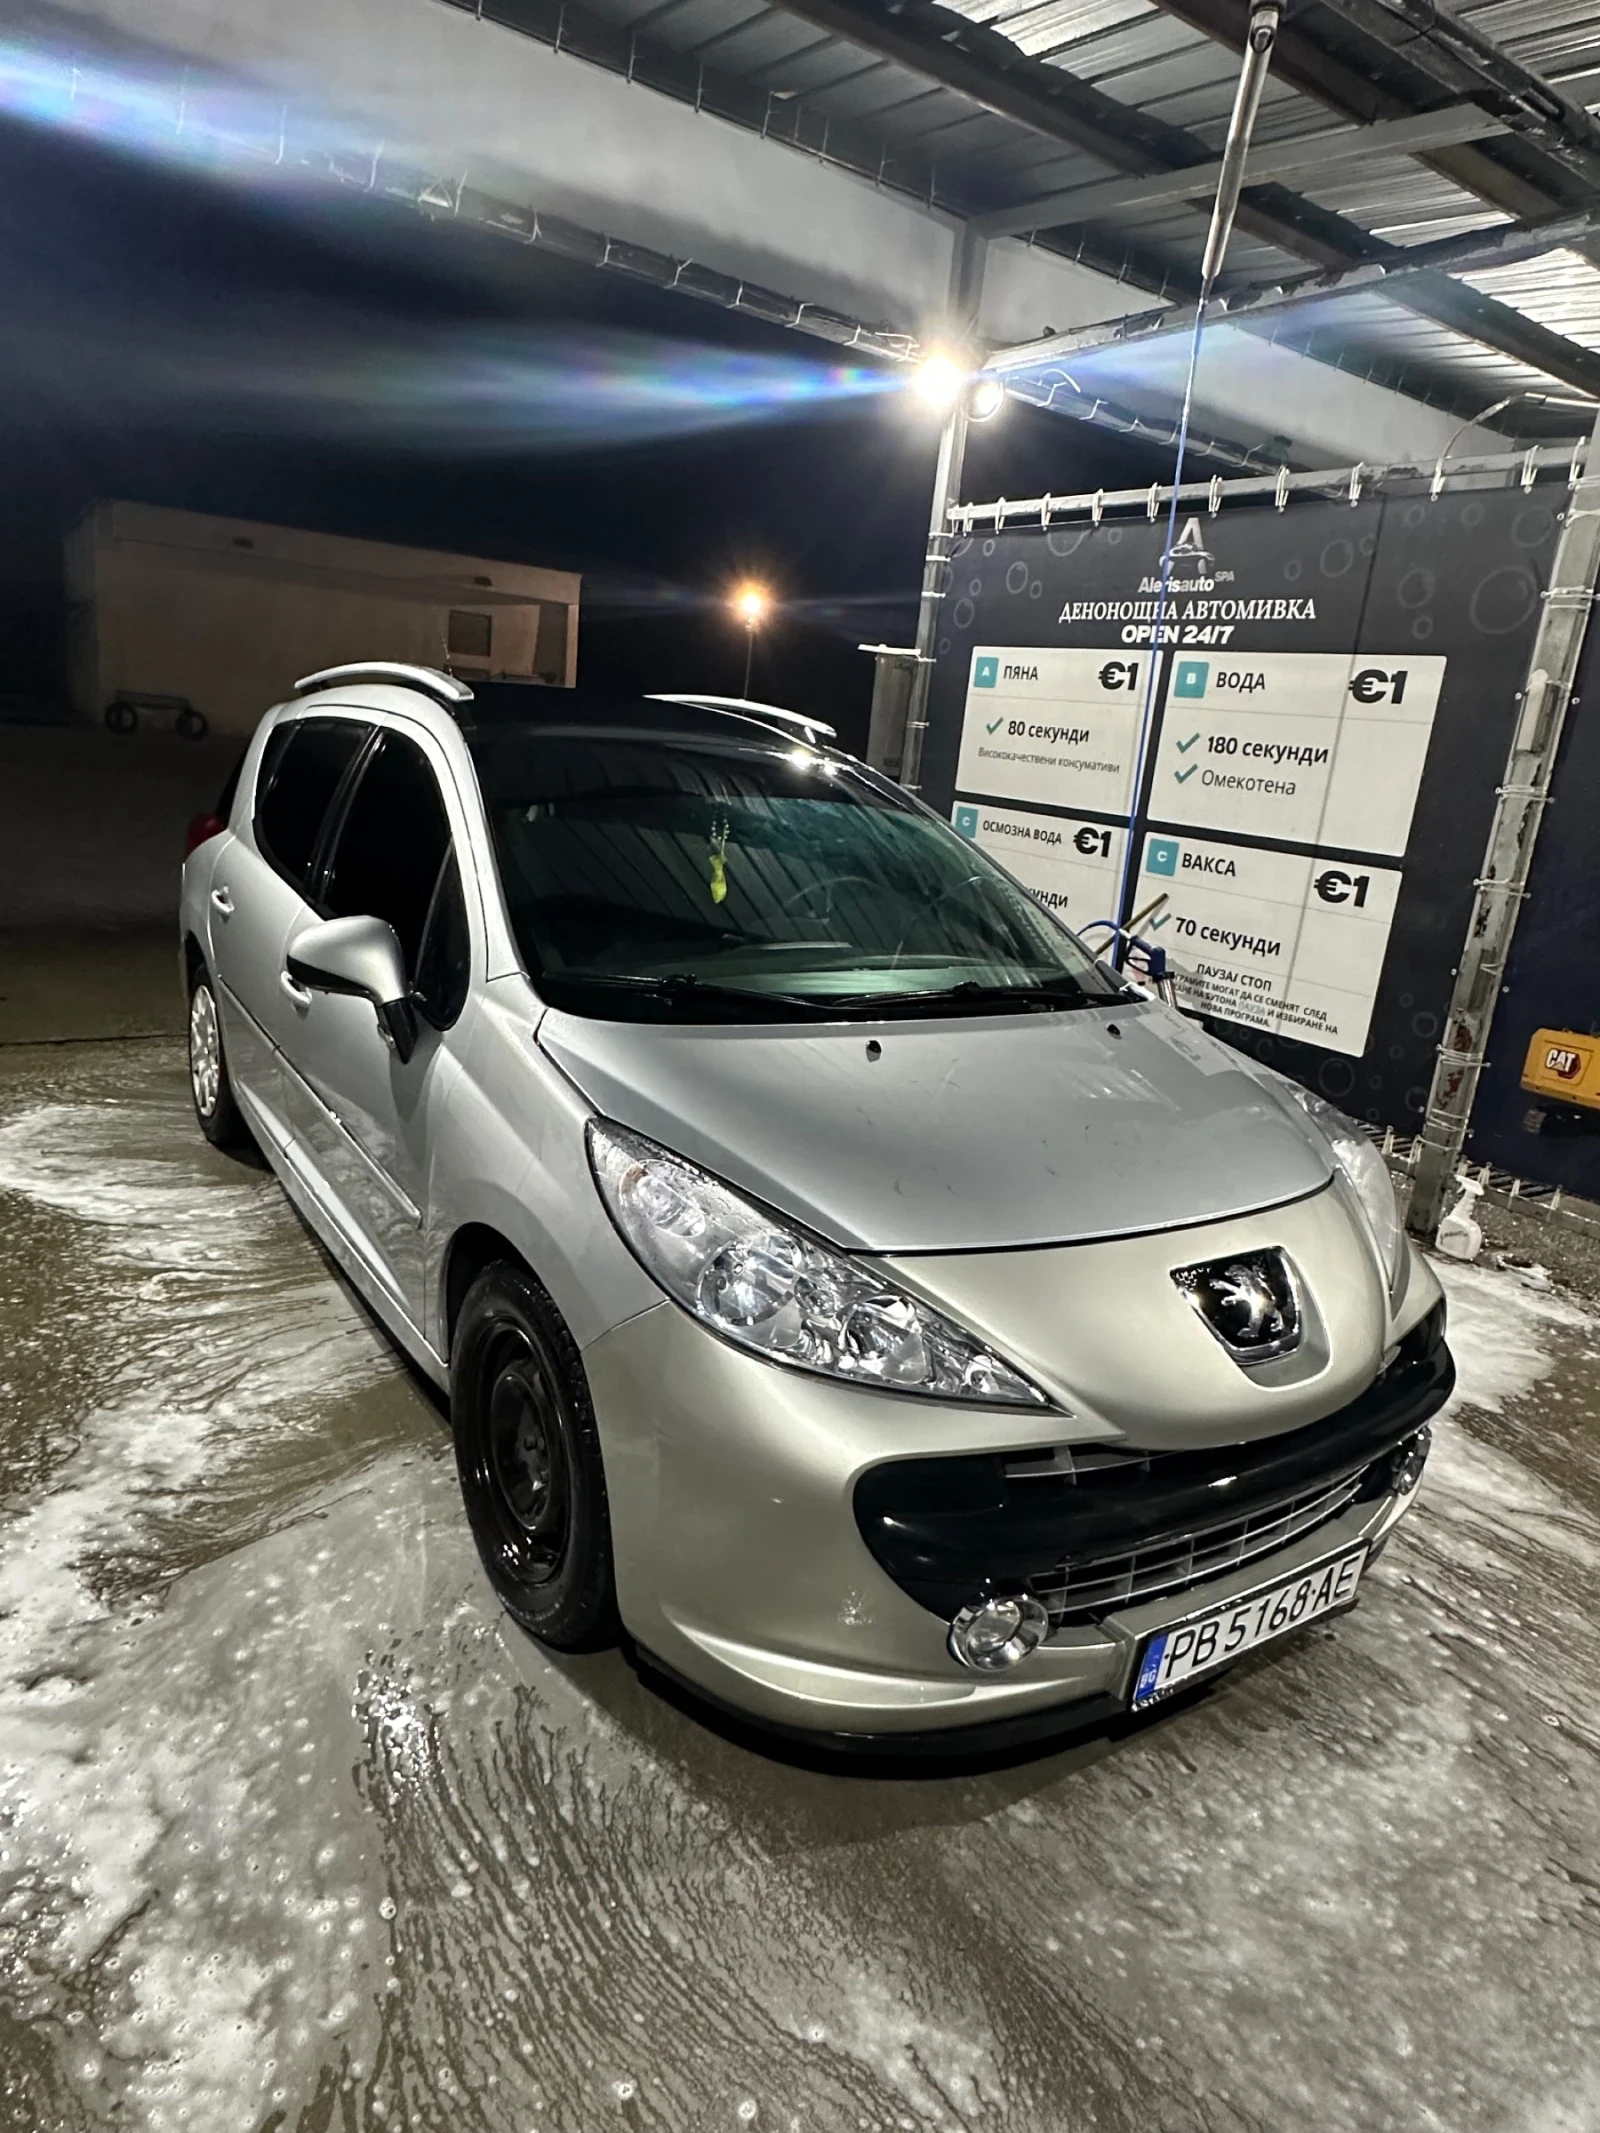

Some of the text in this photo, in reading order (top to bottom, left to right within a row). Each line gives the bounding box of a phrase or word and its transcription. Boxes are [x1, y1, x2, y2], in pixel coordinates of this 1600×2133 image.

[1058, 599, 1316, 624] ДЕНОНОЩНА АВТОМИВКА
[1121, 624, 1235, 644] OPEN 24/7
[1003, 665, 1038, 681] ПЯНА
[1098, 661, 1139, 691] €1
[1216, 672, 1266, 693] ВОДА
[1348, 669, 1408, 704] €1
[1008, 720, 1090, 745] 80 секунди
[978, 747, 1120, 773] Висококачествени консумативи
[1207, 736, 1329, 766] 180 секунди
[1201, 769, 1296, 795] Омекотена
[982, 820, 1062, 846] ОСМОЗНА ВОДА
[1073, 826, 1112, 858] €1
[1181, 852, 1236, 877] ВАКСА
[1314, 870, 1370, 908] €1
[1175, 917, 1281, 956] 70 секунди
[1241, 975, 1272, 992] СТОП
[1201, 1001, 1223, 1014] НОВА
[1205, 992, 1237, 1007] БУТОНА
[1267, 1009, 1275, 1017] И
[1276, 1011, 1325, 1031] ИЗБИРАНЕ
[1325, 1024, 1338, 1035] НА
[1212, 983, 1240, 998] МОГАТ
[1240, 991, 1253, 1001] ДА
[1254, 994, 1264, 1004] СЕ
[1265, 998, 1301, 1014] СМЕНЯТ
[1303, 1007, 1328, 1021] СЛЕД
[1546, 1049, 1575, 1072] CAT
